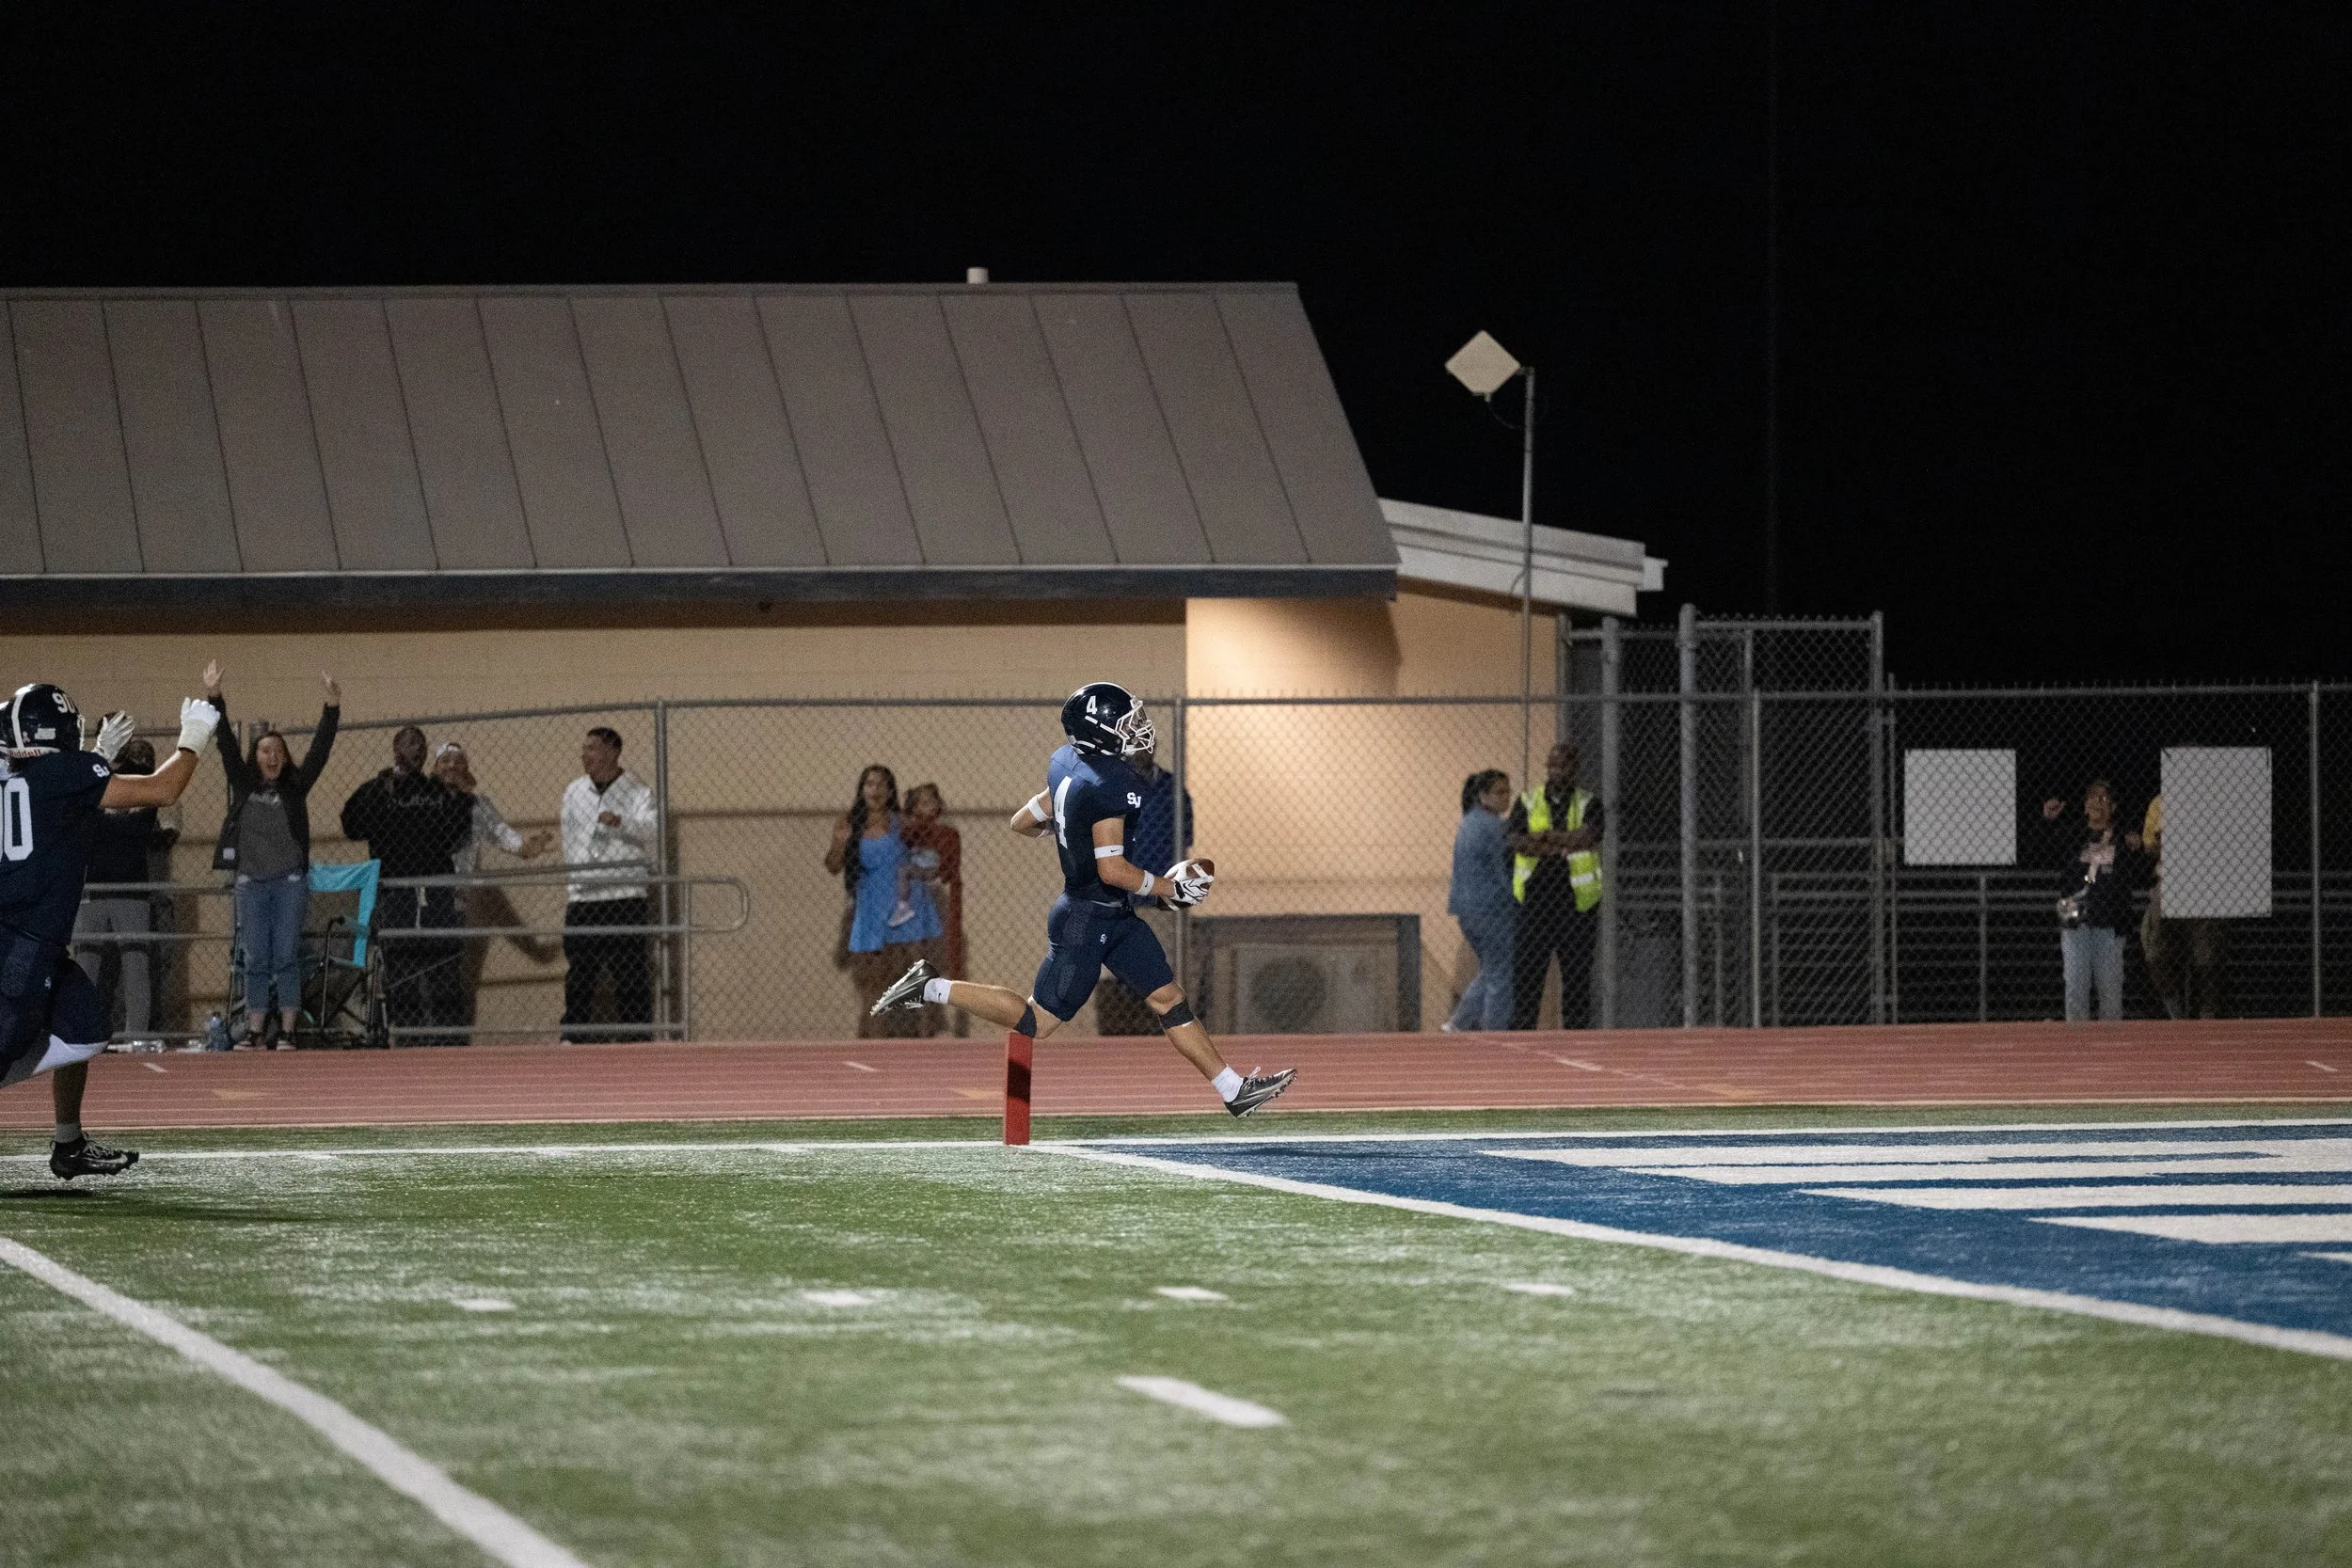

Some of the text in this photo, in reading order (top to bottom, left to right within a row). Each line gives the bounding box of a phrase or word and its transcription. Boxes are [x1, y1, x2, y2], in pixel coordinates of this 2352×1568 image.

[1086, 695, 1098, 715] 4
[0, 778, 33, 862] 0
[1054, 775, 1073, 849] 4
[1126, 792, 1142, 809] SV
